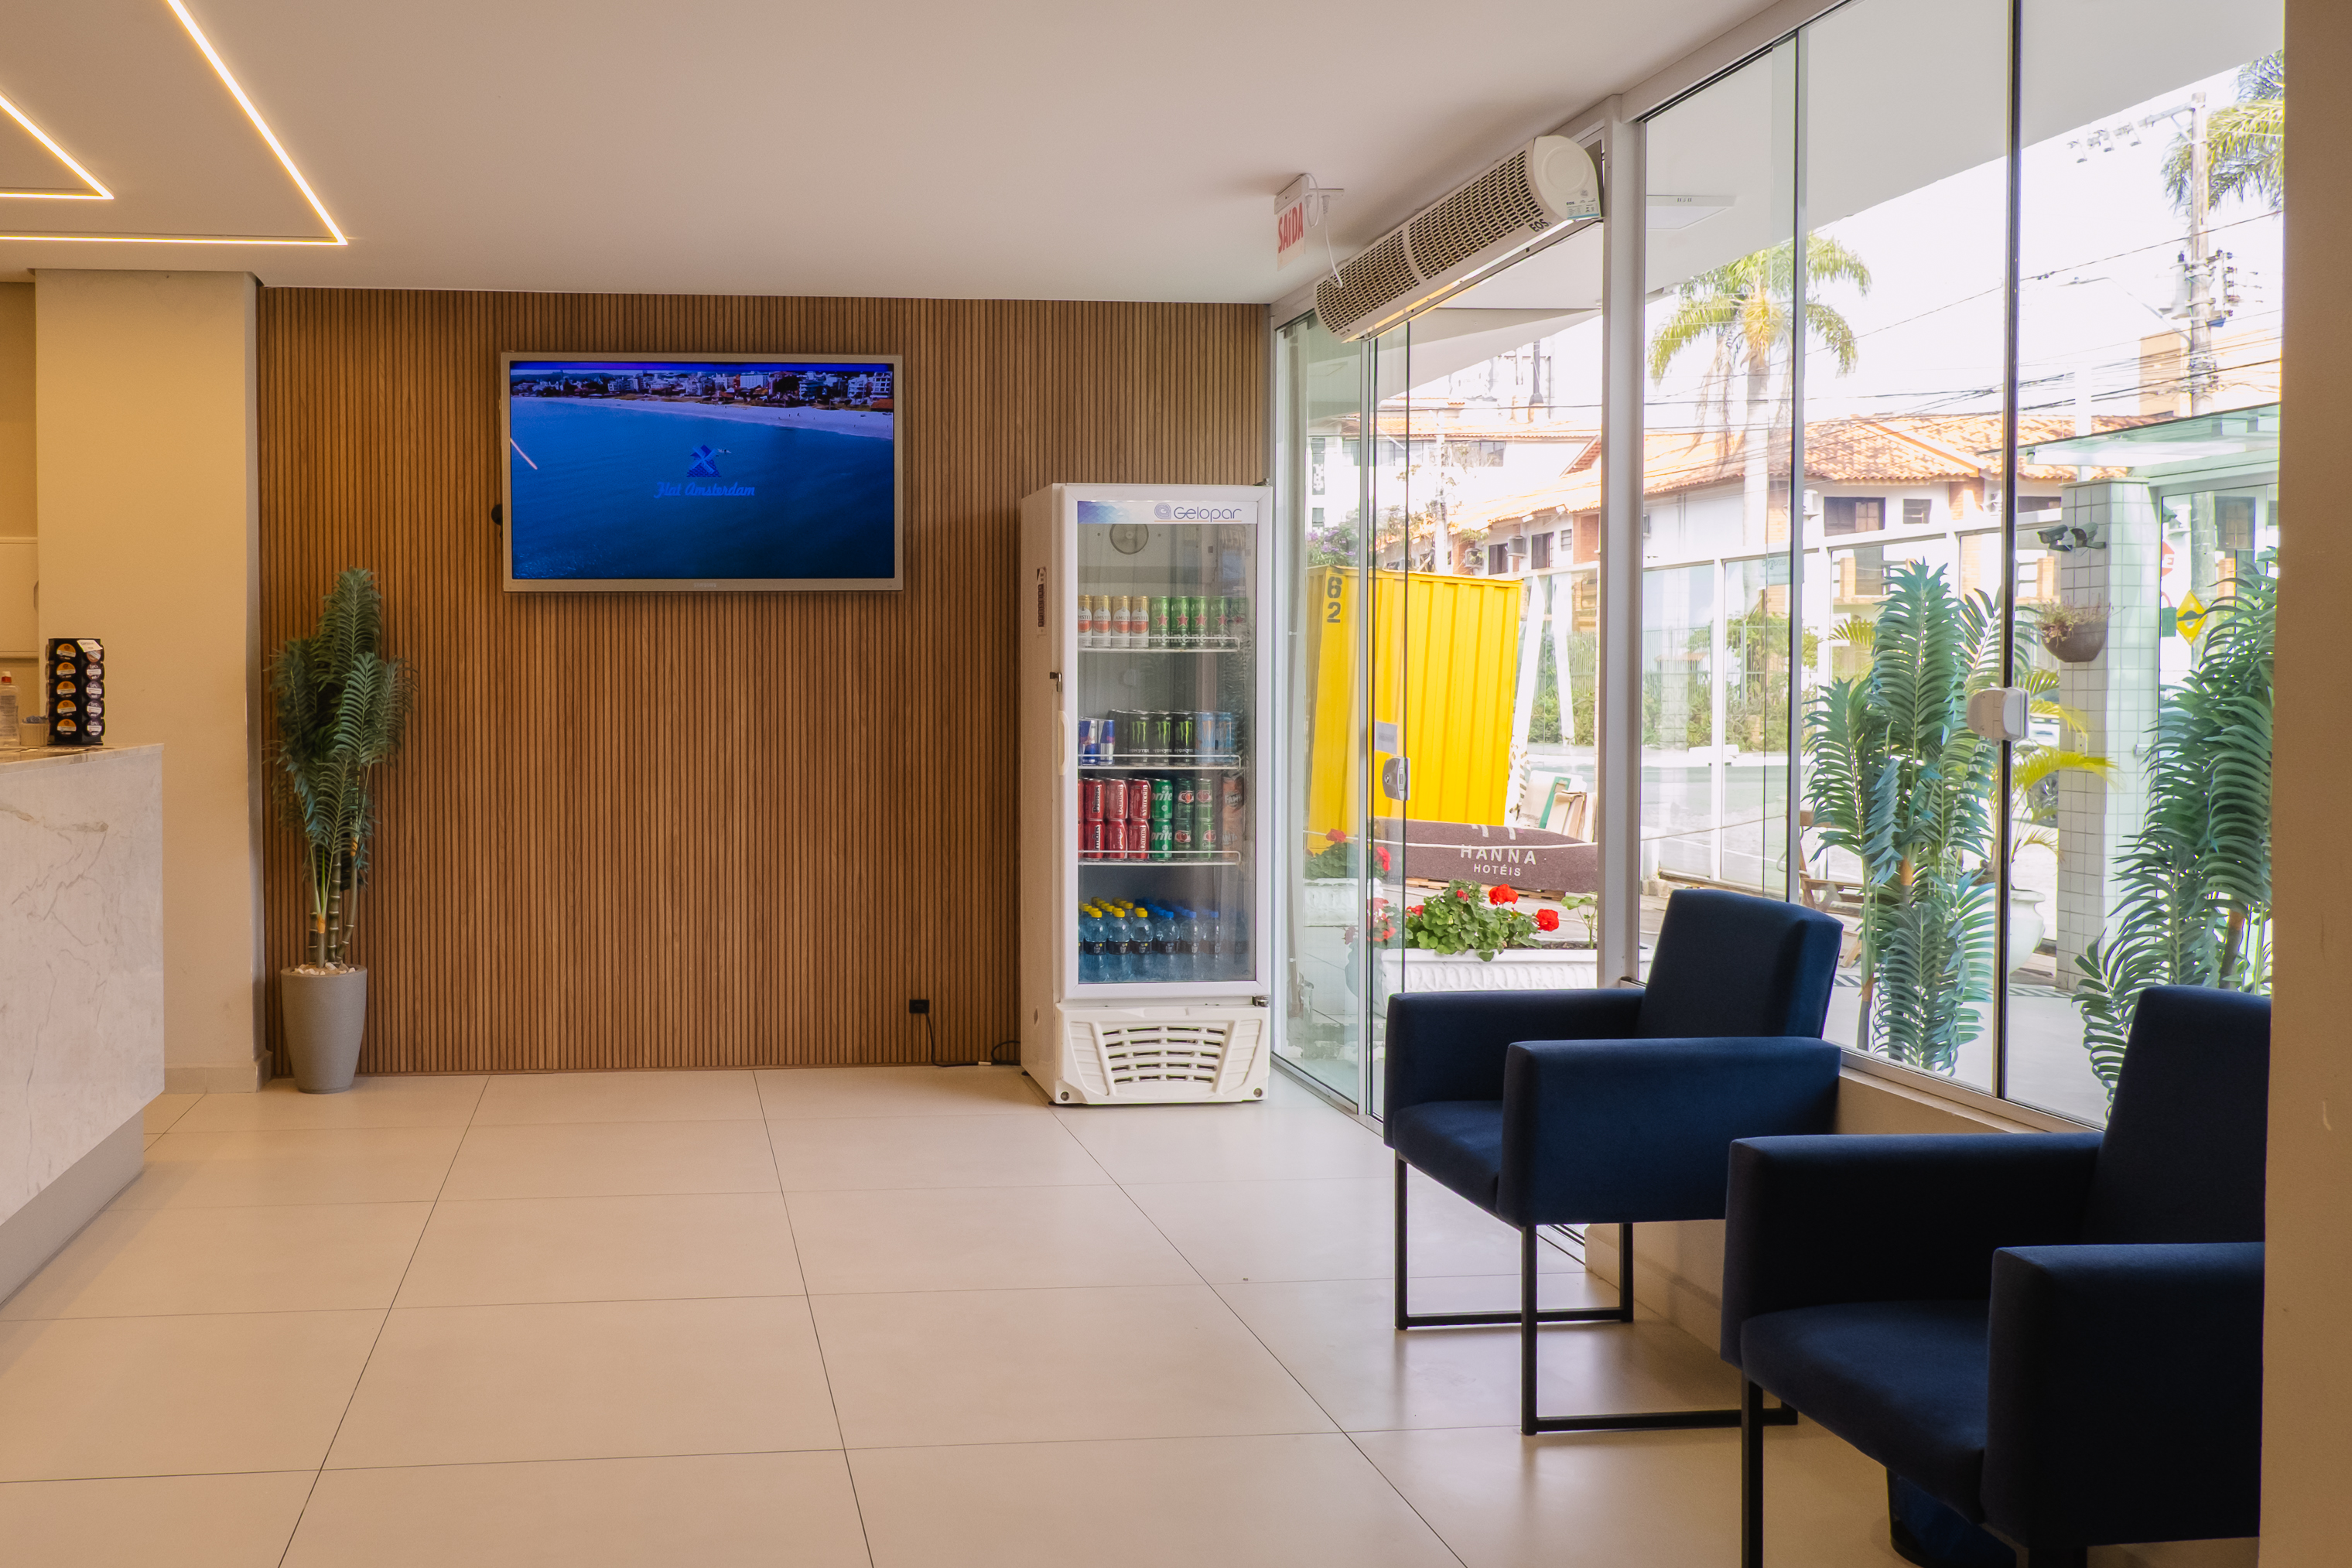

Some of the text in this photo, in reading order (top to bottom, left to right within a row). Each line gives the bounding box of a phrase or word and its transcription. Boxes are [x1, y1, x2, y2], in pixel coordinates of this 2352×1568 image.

[1278, 202, 1304, 254] SAÍDA
[1528, 218, 1549, 232] EOS
[685, 481, 755, 496] Amsterdam
[1174, 507, 1242, 522] Gelopar
[1460, 844, 1537, 865] HANNA
[1473, 863, 1521, 876] HOTÉIS
